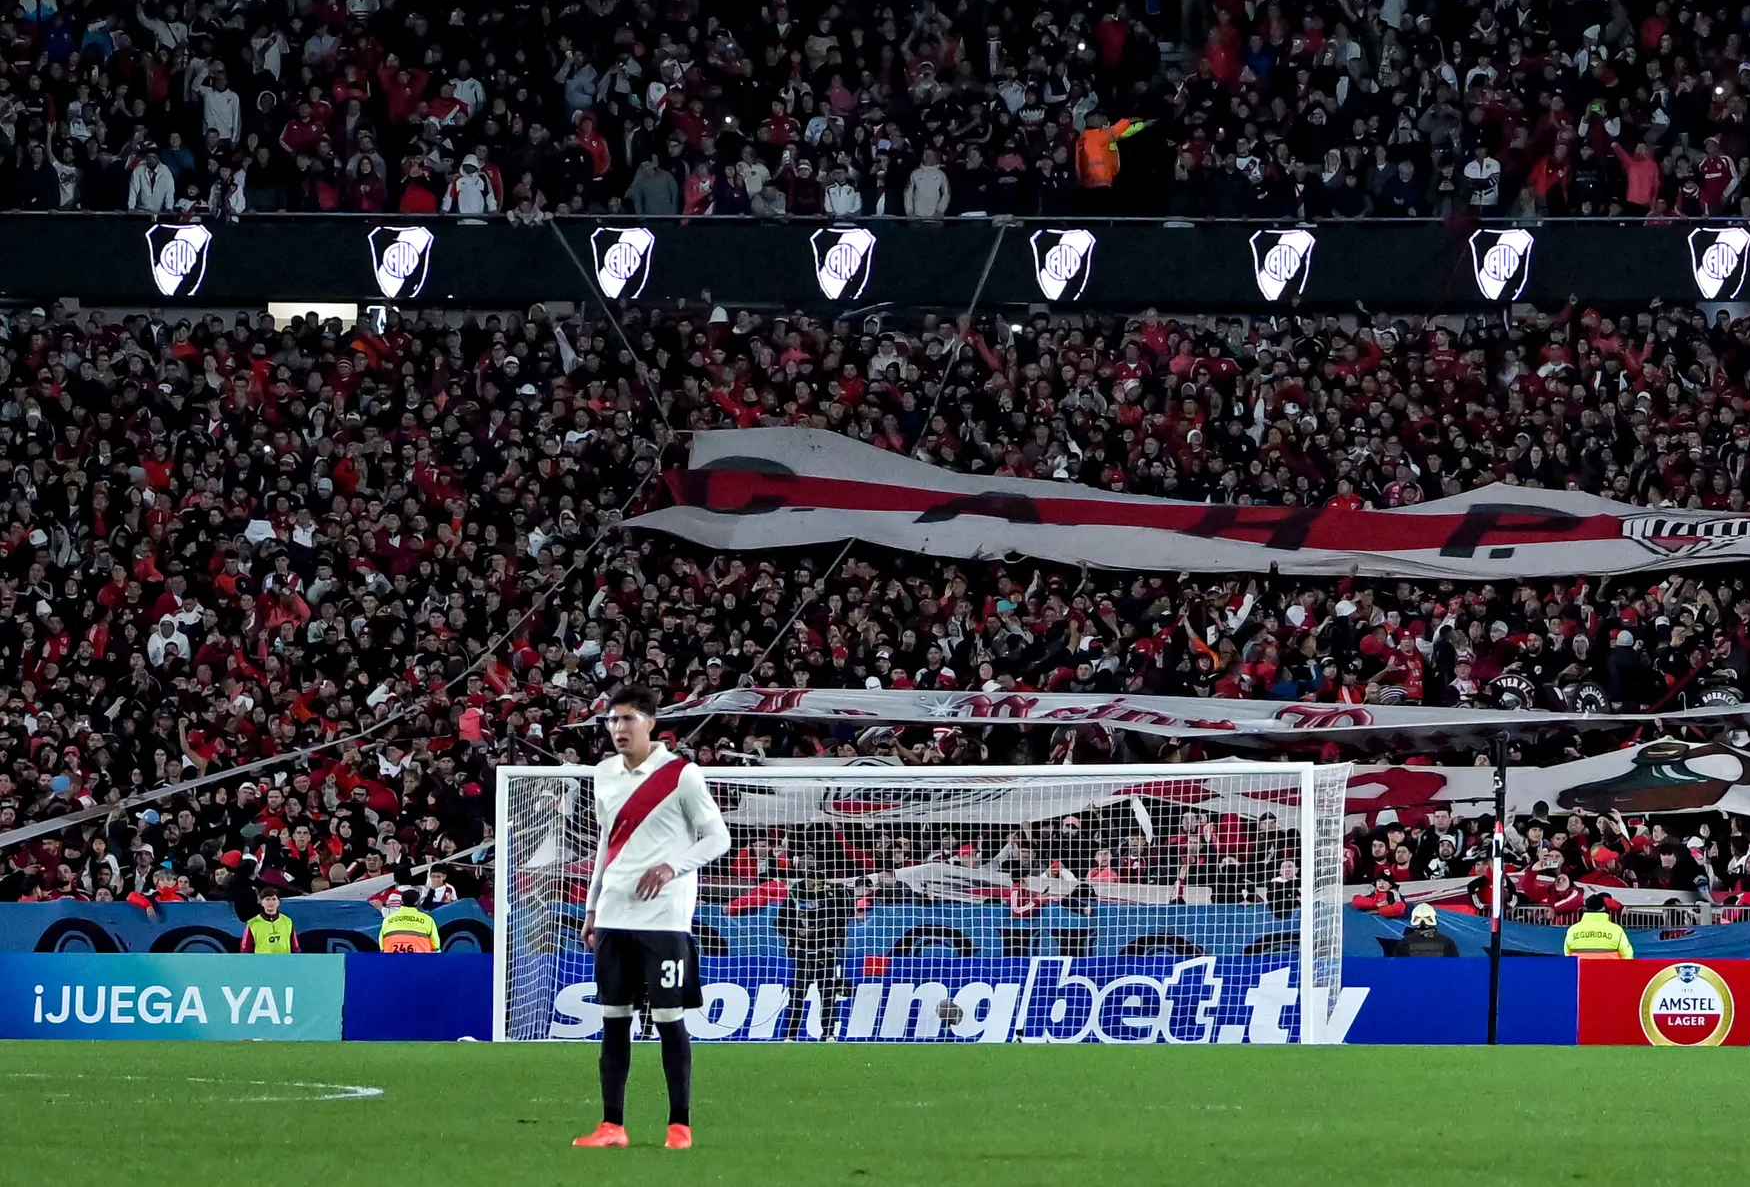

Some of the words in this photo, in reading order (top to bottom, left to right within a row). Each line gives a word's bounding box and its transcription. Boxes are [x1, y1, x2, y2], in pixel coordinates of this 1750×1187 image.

[388, 915, 425, 924] SEGURIDAD
[1572, 930, 1613, 941] SEGURIDAD
[392, 944, 414, 954] 246
[660, 959, 684, 989] 31
[34, 985, 207, 1024] ¡JUEGA
[221, 986, 294, 1024] YA!
[549, 956, 1370, 1045] sortingbet.tv
[1659, 998, 1715, 1011] AMSTEL
[1668, 1016, 1705, 1026] LAGER
